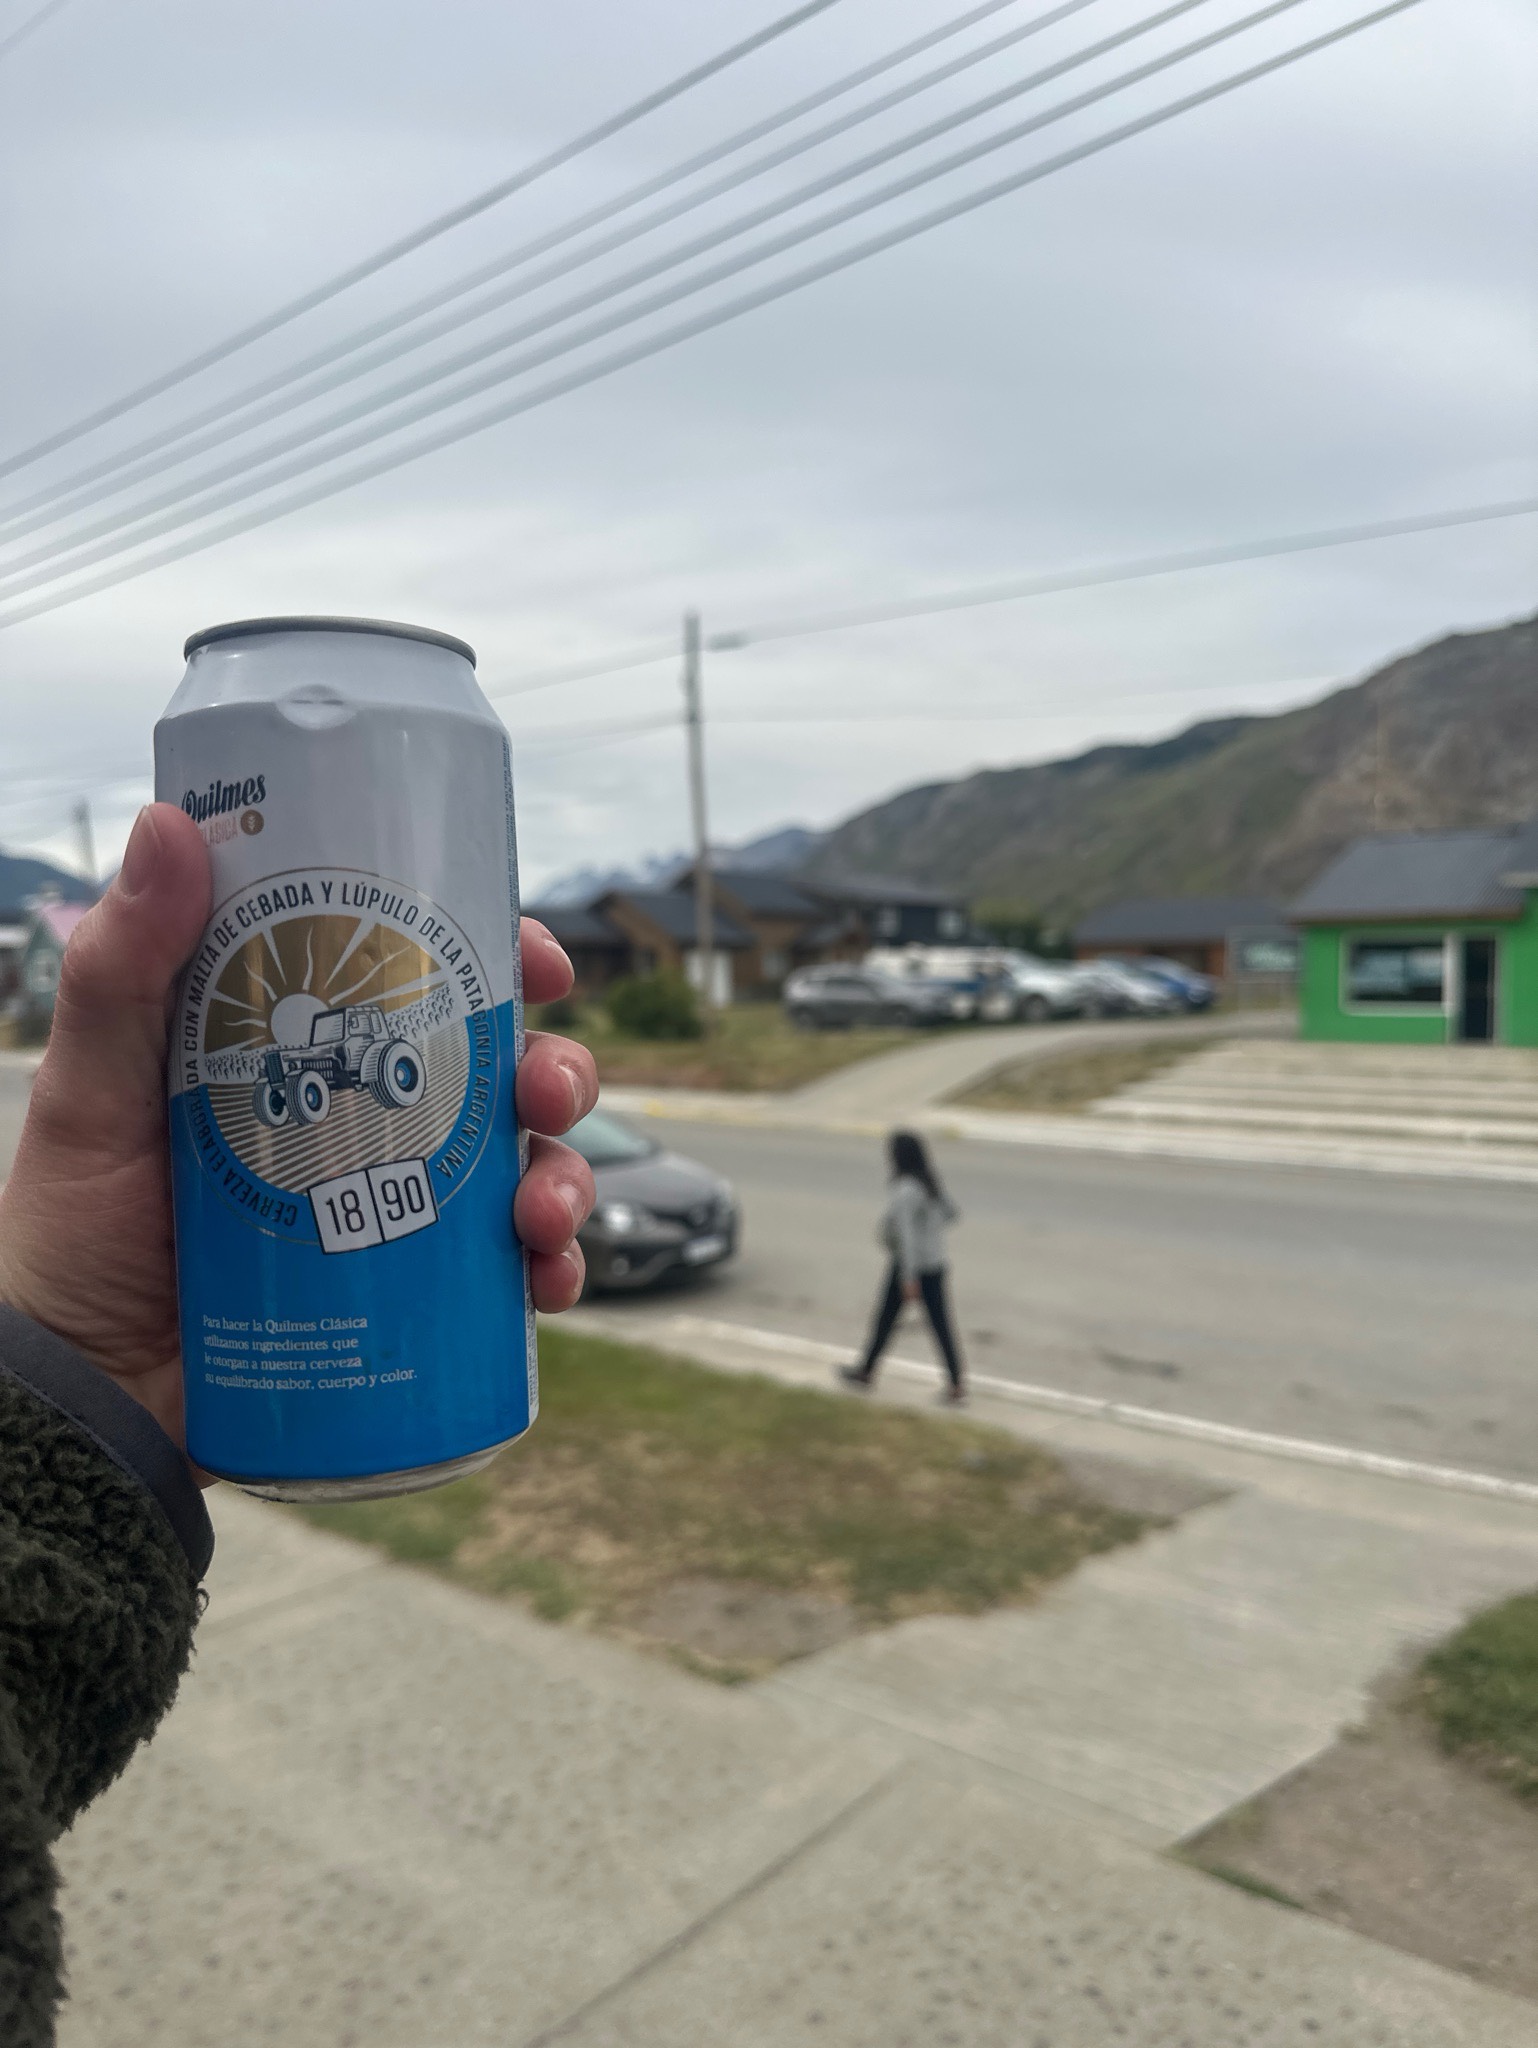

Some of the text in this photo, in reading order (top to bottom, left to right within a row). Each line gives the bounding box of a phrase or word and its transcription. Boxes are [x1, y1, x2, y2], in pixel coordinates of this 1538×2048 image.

[182, 774, 266, 824] Quilmes
[185, 881, 491, 1227] CERVEZA ELABORADA CON MALTA DE CEBADA Y LÚPULO DE LA PATAGONIA ARGENTINA
[325, 1174, 426, 1236] 18 90
[203, 1314, 368, 1334] Para hacer la Quilmes Clásica
[203, 1334, 359, 1354] utilizamos ingredientes que
[204, 1352, 362, 1371] le otorgan a nuestra cerveza
[205, 1373, 214, 1384] su
[215, 1375, 274, 1390] equilibrado
[317, 1375, 366, 1390] cuerpo
[368, 1374, 378, 1388] y
[380, 1368, 418, 1384] color.
